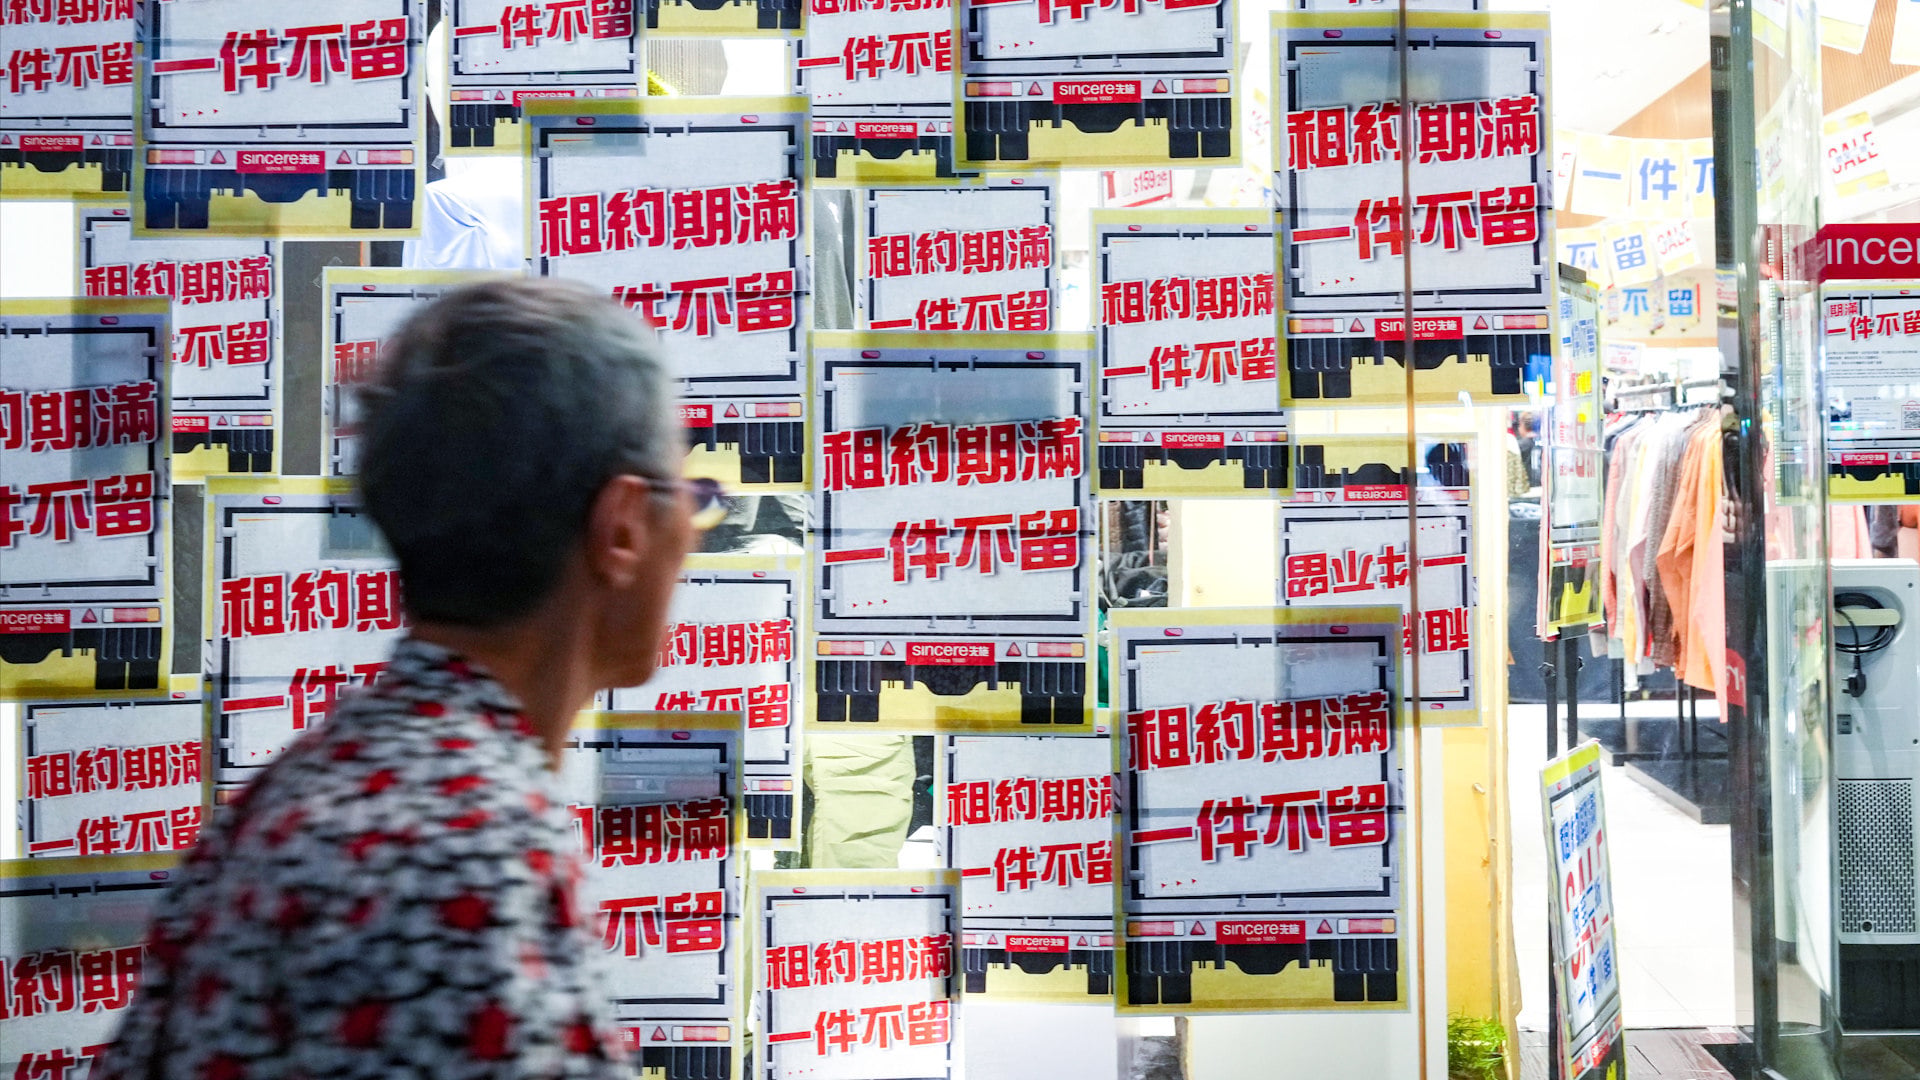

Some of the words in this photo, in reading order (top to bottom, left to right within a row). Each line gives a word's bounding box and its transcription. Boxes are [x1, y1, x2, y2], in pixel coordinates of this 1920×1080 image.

[456, 0, 631, 48] 一件不留
[0, 42, 132, 92] 件不留
[155, 18, 405, 91] 一件不留
[1059, 84, 1115, 95] sincere
[859, 124, 897, 132] sincere
[1288, 96, 1536, 169] 租約期滿
[243, 153, 299, 165] sincere
[540, 180, 795, 256] 租約期滿
[1293, 186, 1535, 259] 一件不留
[869, 226, 1049, 278] 租約期滿
[1826, 237, 1920, 265] ince
[86, 257, 269, 304] 租約期滿
[613, 271, 792, 335] 件不留
[1102, 274, 1274, 325] 租約期滿
[871, 290, 1047, 331] 一件不留
[1828, 311, 1920, 340] 一件不留
[173, 321, 267, 367] 不留
[1104, 338, 1275, 389] 一件不留
[0, 383, 155, 452] 期滿
[1166, 433, 1202, 442] sincere
[824, 418, 1080, 491] 租約期滿
[0, 474, 151, 546] 不留
[826, 509, 1077, 581] 一件不留
[0, 614, 42, 625] ncere
[222, 570, 401, 637] 租約期
[658, 619, 790, 667] 約期滿
[911, 645, 969, 656] sincere
[1128, 693, 1387, 770] 租約期滿
[28, 742, 202, 798] 租約期滿
[31, 806, 200, 856] 一件不留
[568, 800, 728, 867] 期滿
[1133, 784, 1385, 860] 一件不留
[600, 892, 722, 956] 不留
[1009, 937, 1048, 946] sincere
[1222, 924, 1279, 936] sincere
[767, 934, 950, 989] 租約期滿
[769, 1000, 948, 1055] 一件不留
